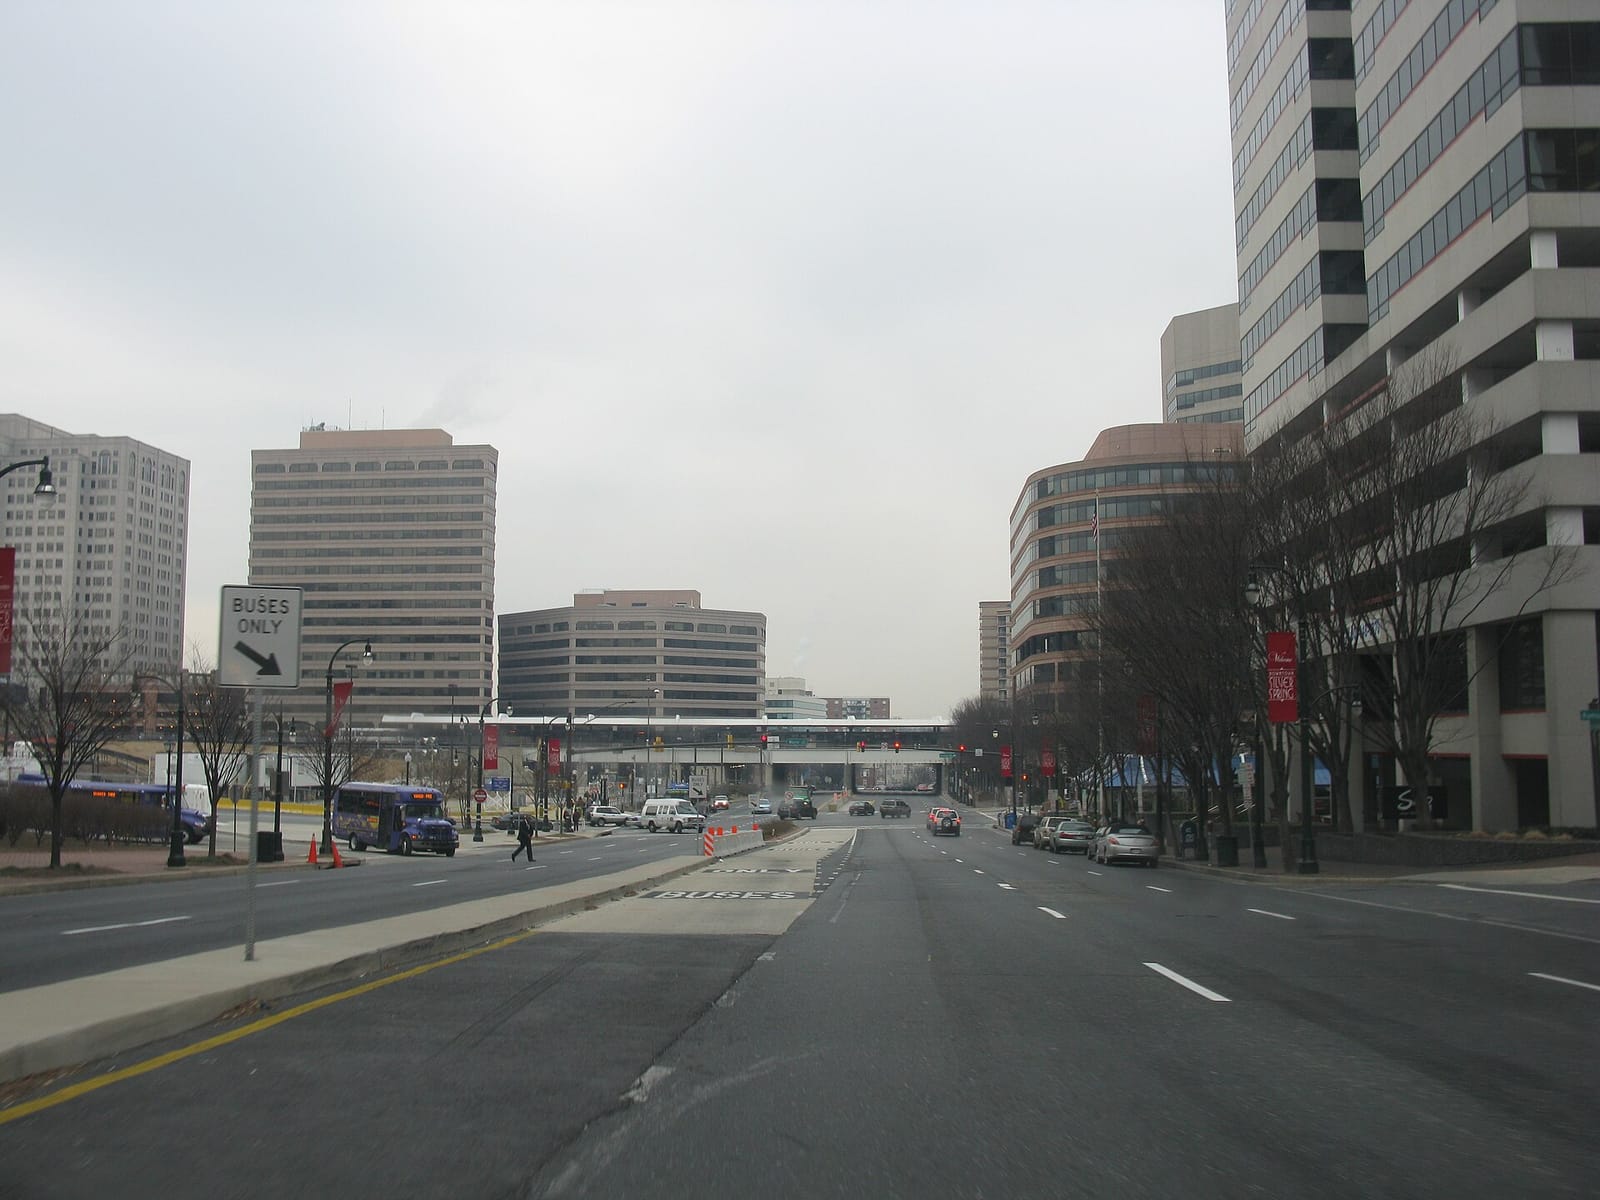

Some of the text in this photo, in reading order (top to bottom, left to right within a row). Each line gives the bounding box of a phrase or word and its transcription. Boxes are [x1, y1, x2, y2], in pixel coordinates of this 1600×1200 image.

[233, 598, 289, 614] BUSES
[238, 619, 282, 634] ONLY
[1269, 677, 1295, 688] SILVER
[1269, 688, 1295, 699] SPRING
[653, 891, 796, 899] BUSES
